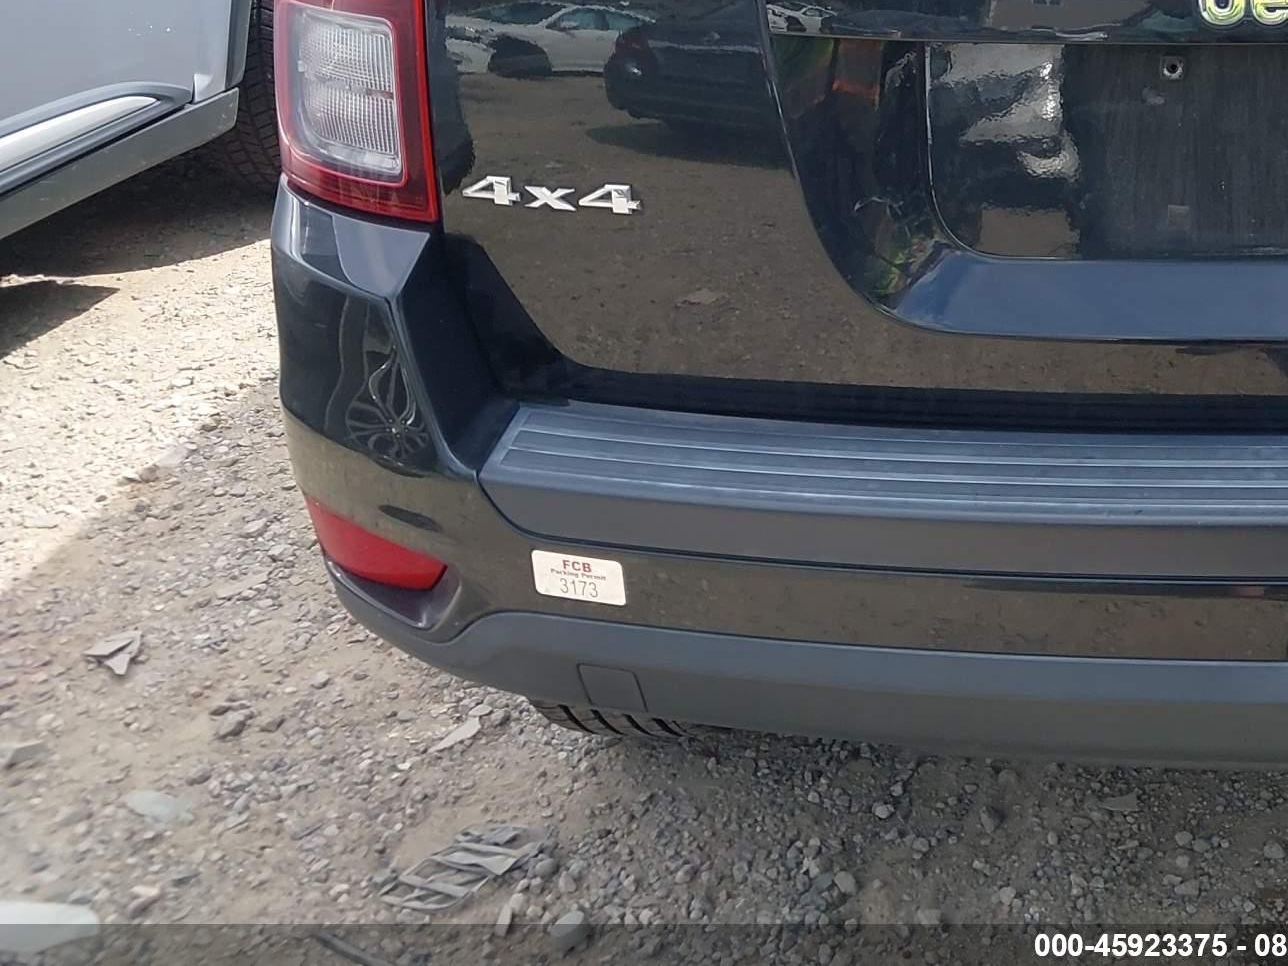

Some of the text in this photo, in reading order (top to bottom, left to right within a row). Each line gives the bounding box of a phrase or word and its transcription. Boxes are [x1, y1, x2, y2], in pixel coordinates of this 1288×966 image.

[462, 175, 641, 215] 4x4
[562, 559, 592, 572] FCB
[560, 577, 598, 598] 3173
